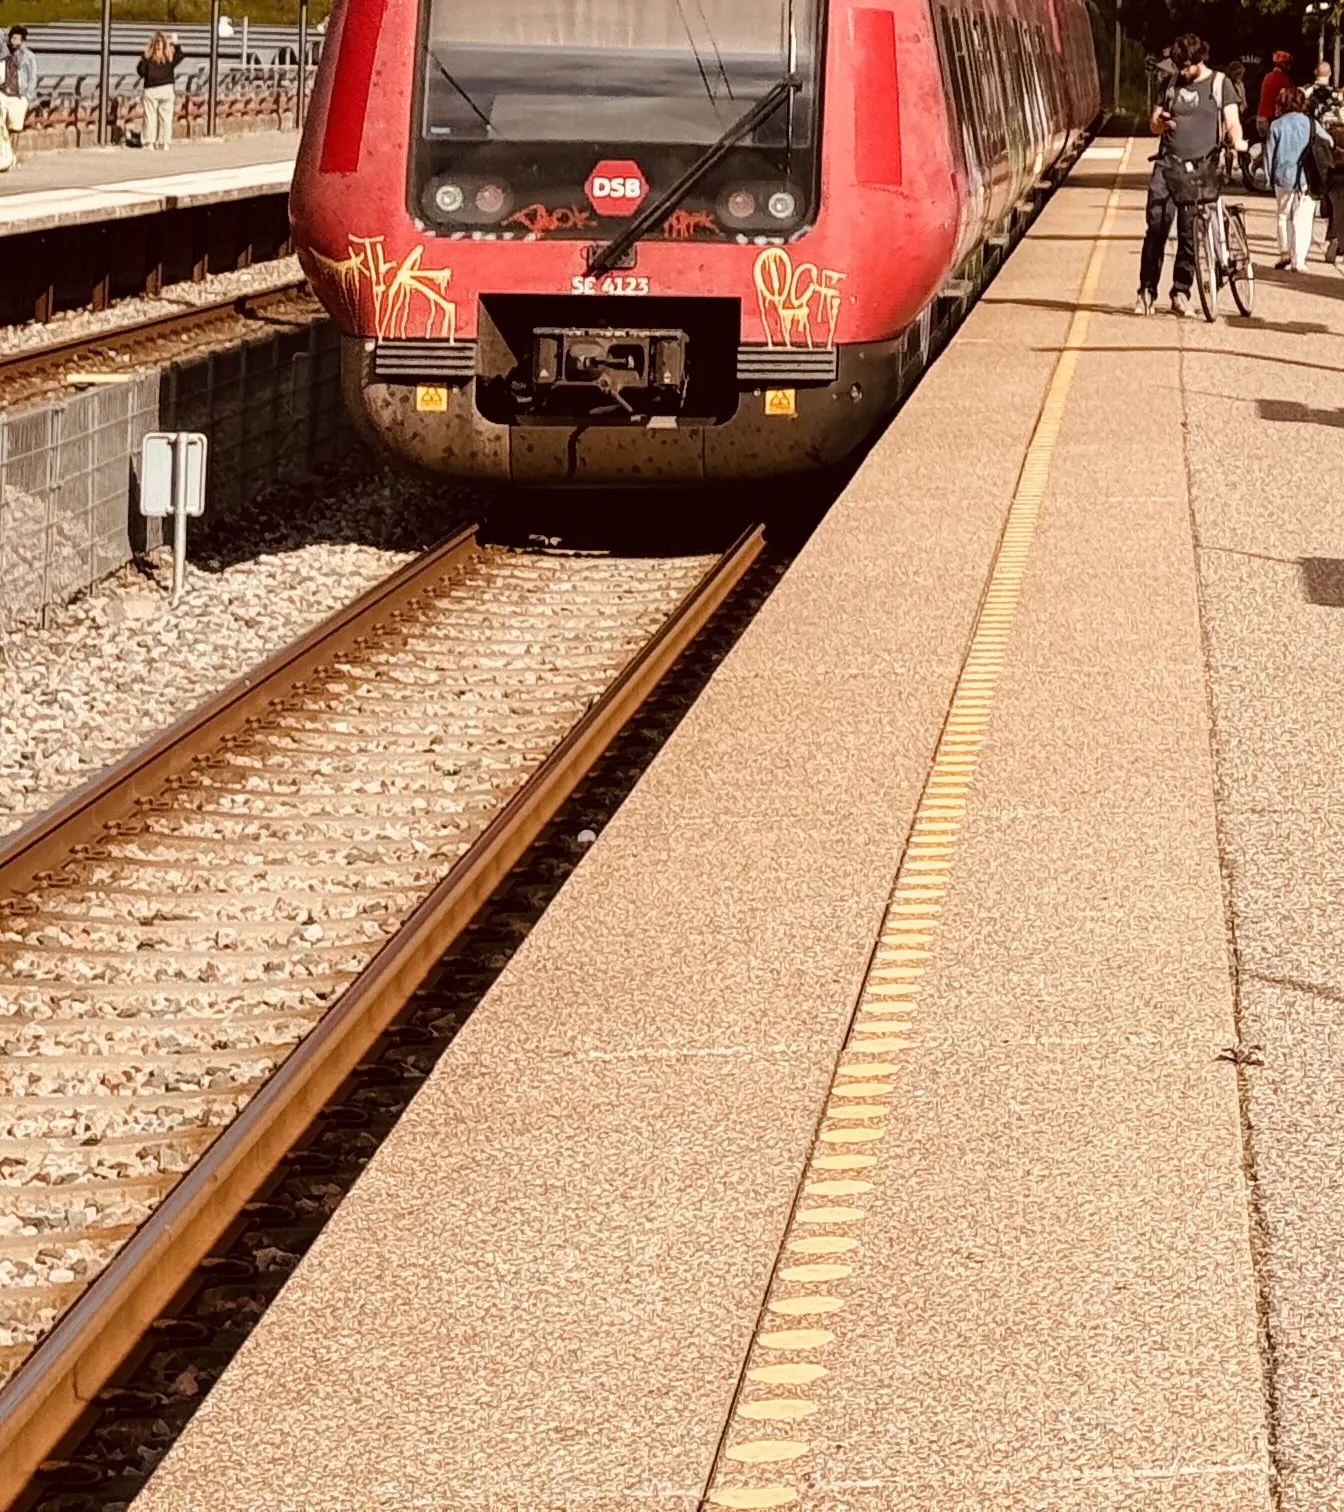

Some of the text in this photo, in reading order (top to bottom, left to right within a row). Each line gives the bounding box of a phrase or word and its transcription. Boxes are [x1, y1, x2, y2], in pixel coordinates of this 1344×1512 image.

[592, 177, 641, 198] DSB
[571, 276, 649, 296] SE 4123
